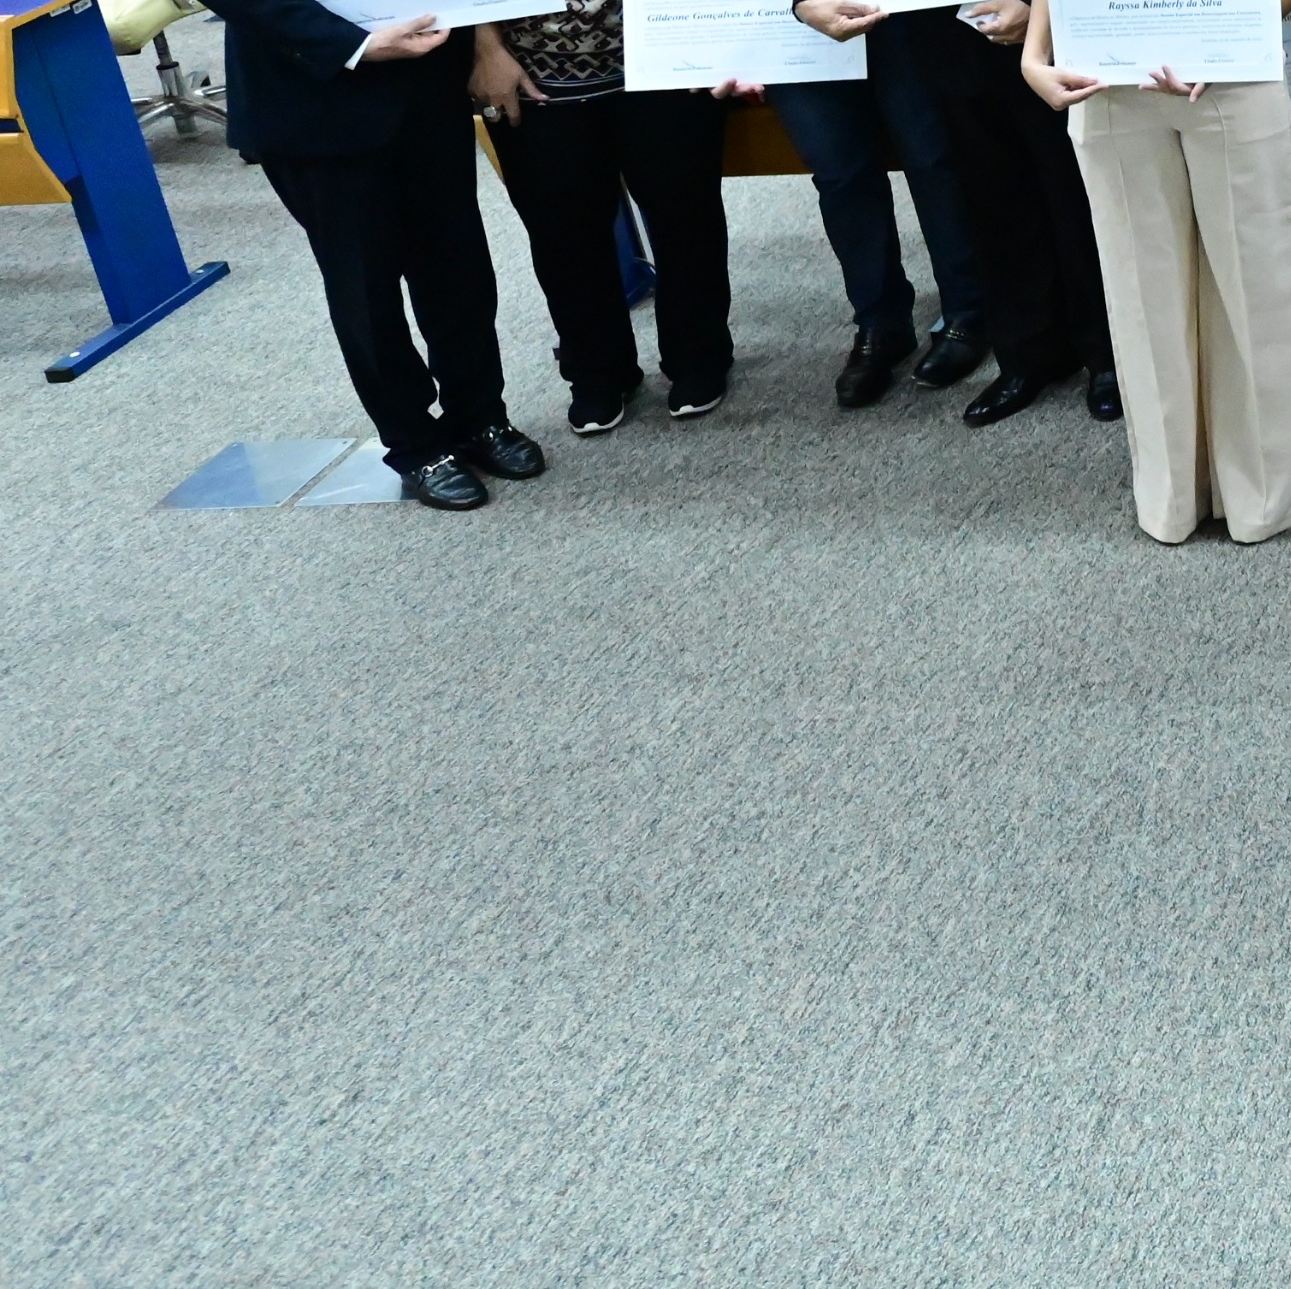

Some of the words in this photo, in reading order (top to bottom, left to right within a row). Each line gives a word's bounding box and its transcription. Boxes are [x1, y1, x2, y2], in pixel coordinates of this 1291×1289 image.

[1108, 2, 1140, 11] Rayssa
[1142, 0, 1183, 9] Kimberly
[1186, 0, 1198, 7] da
[1199, 0, 1223, 7] Silva
[692, 11, 741, 20] Gonçalves
